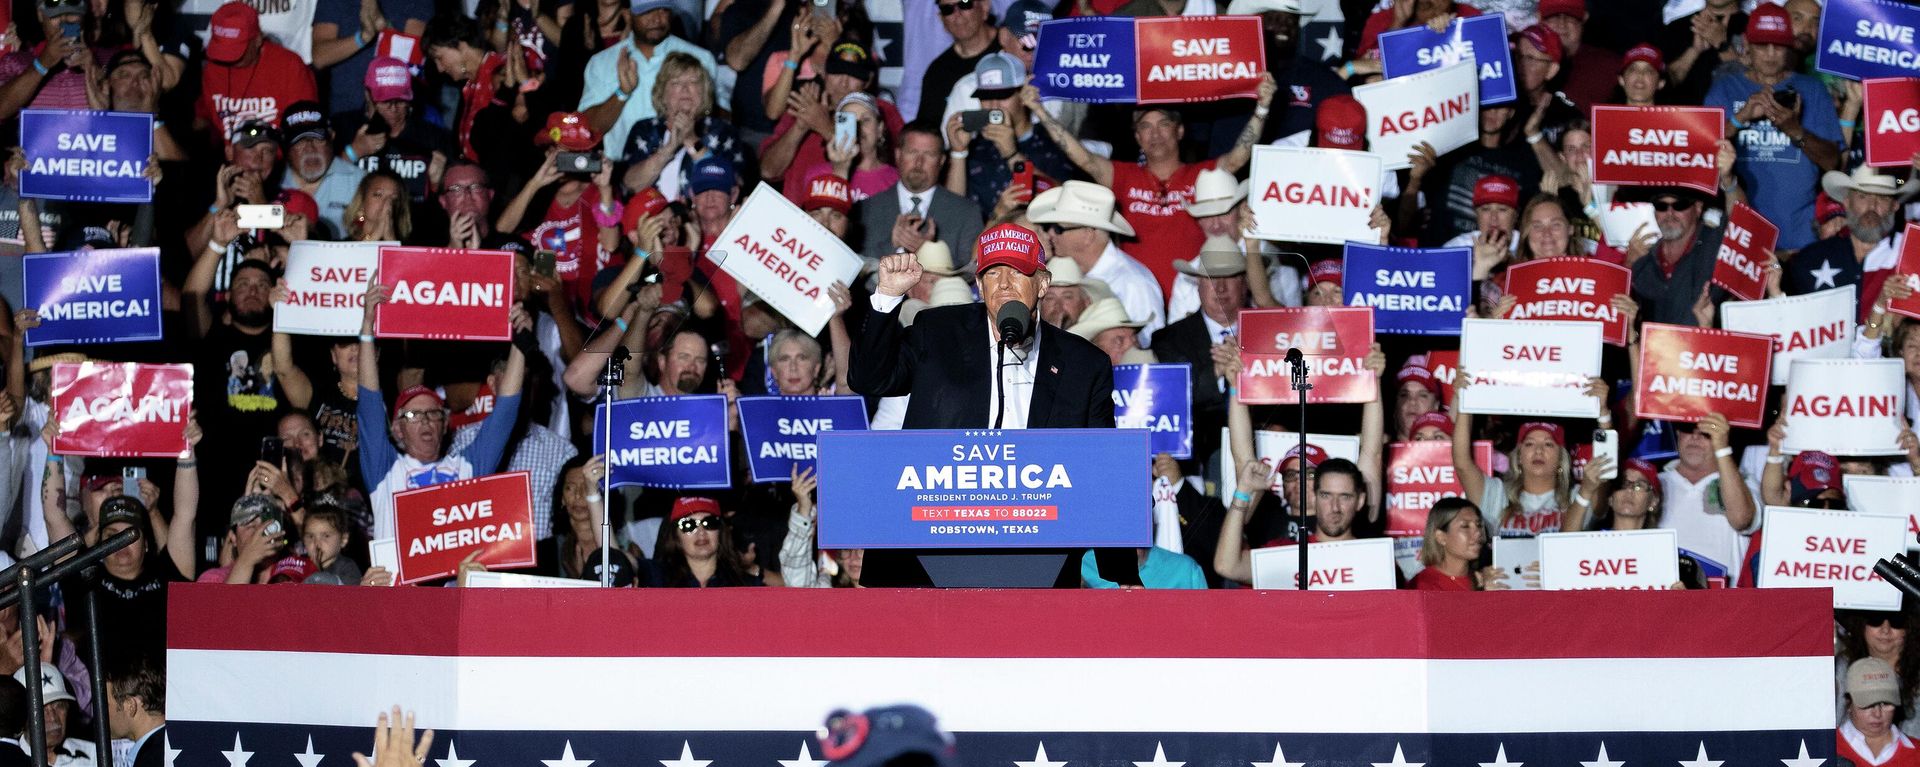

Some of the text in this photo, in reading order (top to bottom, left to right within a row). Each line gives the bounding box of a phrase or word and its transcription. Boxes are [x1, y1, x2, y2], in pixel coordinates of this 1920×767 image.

[1067, 33, 1107, 48] TEXT
[1856, 20, 1915, 44] SAVE
[1172, 38, 1231, 57] SAVE
[1416, 41, 1474, 66] SAVE
[1059, 54, 1111, 68] RALLY
[1047, 73, 1125, 88] TO 88022
[1148, 62, 1257, 82] AMERICA!
[1379, 93, 1470, 136] AGAIN!
[57, 133, 117, 153] SAVE
[1629, 128, 1689, 147] SAVE
[1738, 128, 1791, 146] TRUM
[30, 157, 142, 179] AMERICA!
[1603, 150, 1715, 169] AMERICA!
[811, 180, 849, 201] MAGA
[1262, 181, 1371, 209] AGAIN!
[980, 229, 1035, 245] MAKE AMERICA
[771, 227, 824, 271] SAVE
[984, 242, 1030, 255] GREAT AGAIN
[734, 234, 822, 301] AMERICA
[1718, 243, 1763, 282] RICA!
[61, 274, 122, 295] SAVE
[311, 267, 367, 283] SAVE
[1375, 269, 1436, 289] SAVE
[389, 280, 505, 308] AGAIN!
[1536, 277, 1597, 296] SAVE
[286, 291, 366, 308] AMERIC
[1350, 291, 1462, 313] AMERICA!
[37, 299, 151, 321] AMERICA!
[1510, 300, 1619, 323] AMERICA!
[1274, 332, 1337, 351] SAVE
[1769, 321, 1846, 354] GAIN!
[1503, 345, 1563, 362] SAVE
[1679, 352, 1738, 375] SAVE
[1112, 389, 1154, 408] AVE
[1649, 375, 1758, 402] AMERICA!
[66, 396, 182, 423] AGAIN!
[1791, 396, 1897, 417] AGAIN!
[629, 420, 691, 440] SAVE
[610, 445, 718, 467] AMERICA!
[760, 442, 818, 460] AMER
[952, 444, 1016, 462] SAVE
[896, 463, 1073, 490] AMERICA
[1393, 466, 1455, 483] SAVE
[916, 494, 967, 502] PRESIDENT
[1021, 493, 1052, 501] TRUMP
[432, 499, 493, 526] SAVE
[922, 508, 1047, 518] TEXT TEXAS TO 88022
[408, 522, 522, 557] AMERICA!
[930, 525, 1039, 536] ROBSTOWN, TEXAS
[1806, 536, 1867, 554] SAVE
[1578, 559, 1638, 577] SAVE
